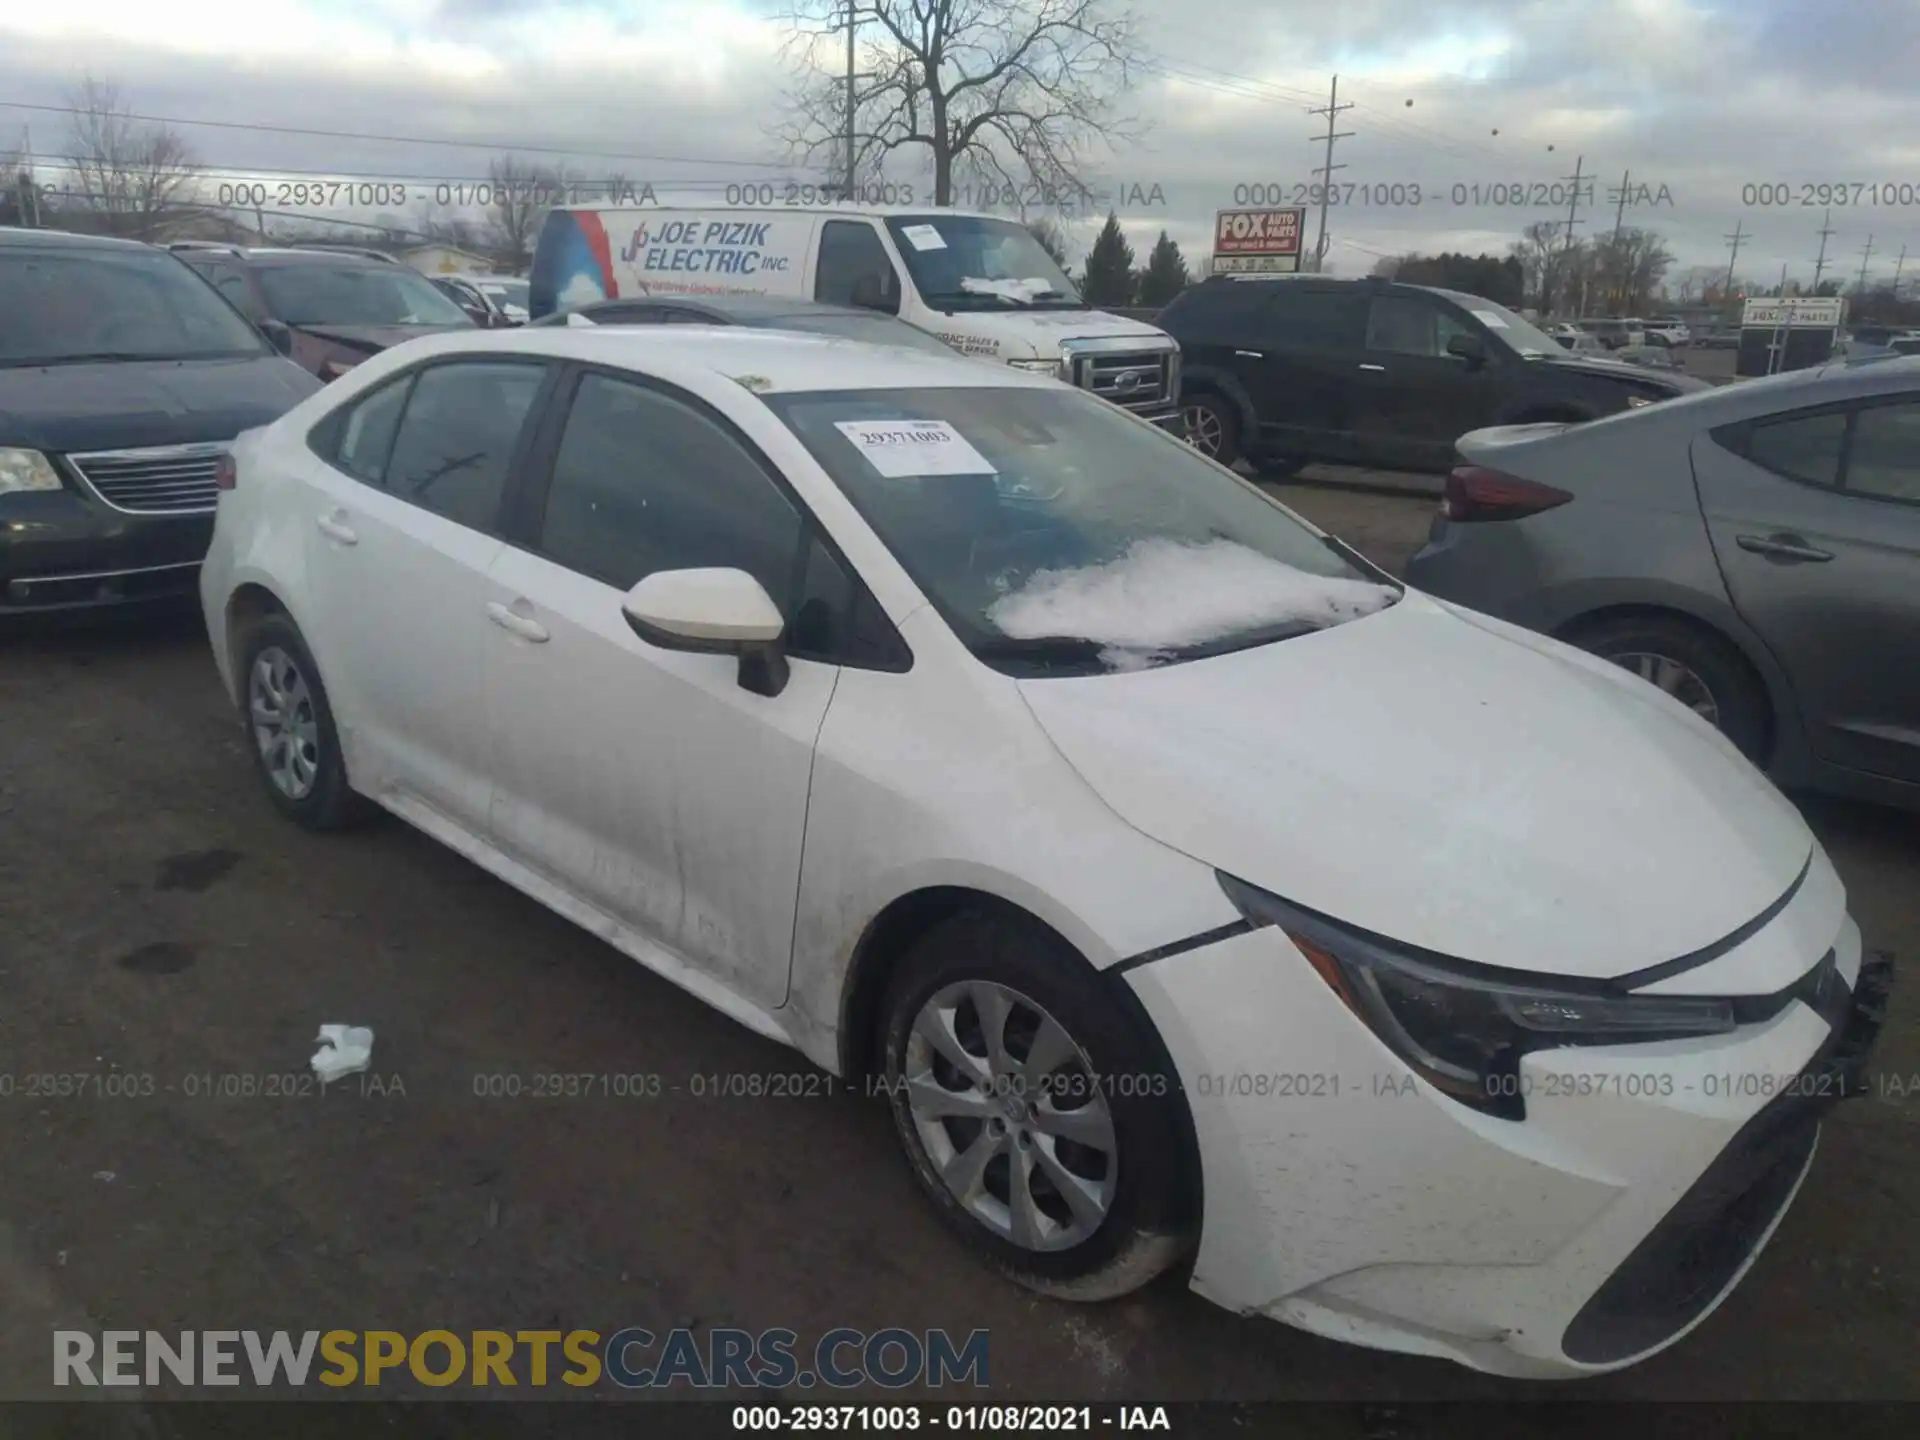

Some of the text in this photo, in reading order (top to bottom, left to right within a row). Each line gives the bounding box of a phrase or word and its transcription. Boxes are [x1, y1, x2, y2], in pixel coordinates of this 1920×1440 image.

[1220, 213, 1267, 240] FOX
[1267, 212, 1295, 225] AUTO
[651, 221, 772, 246] JOE PIZIK
[643, 247, 761, 274] ELECTRIC
[860, 431, 952, 445] 29371003
